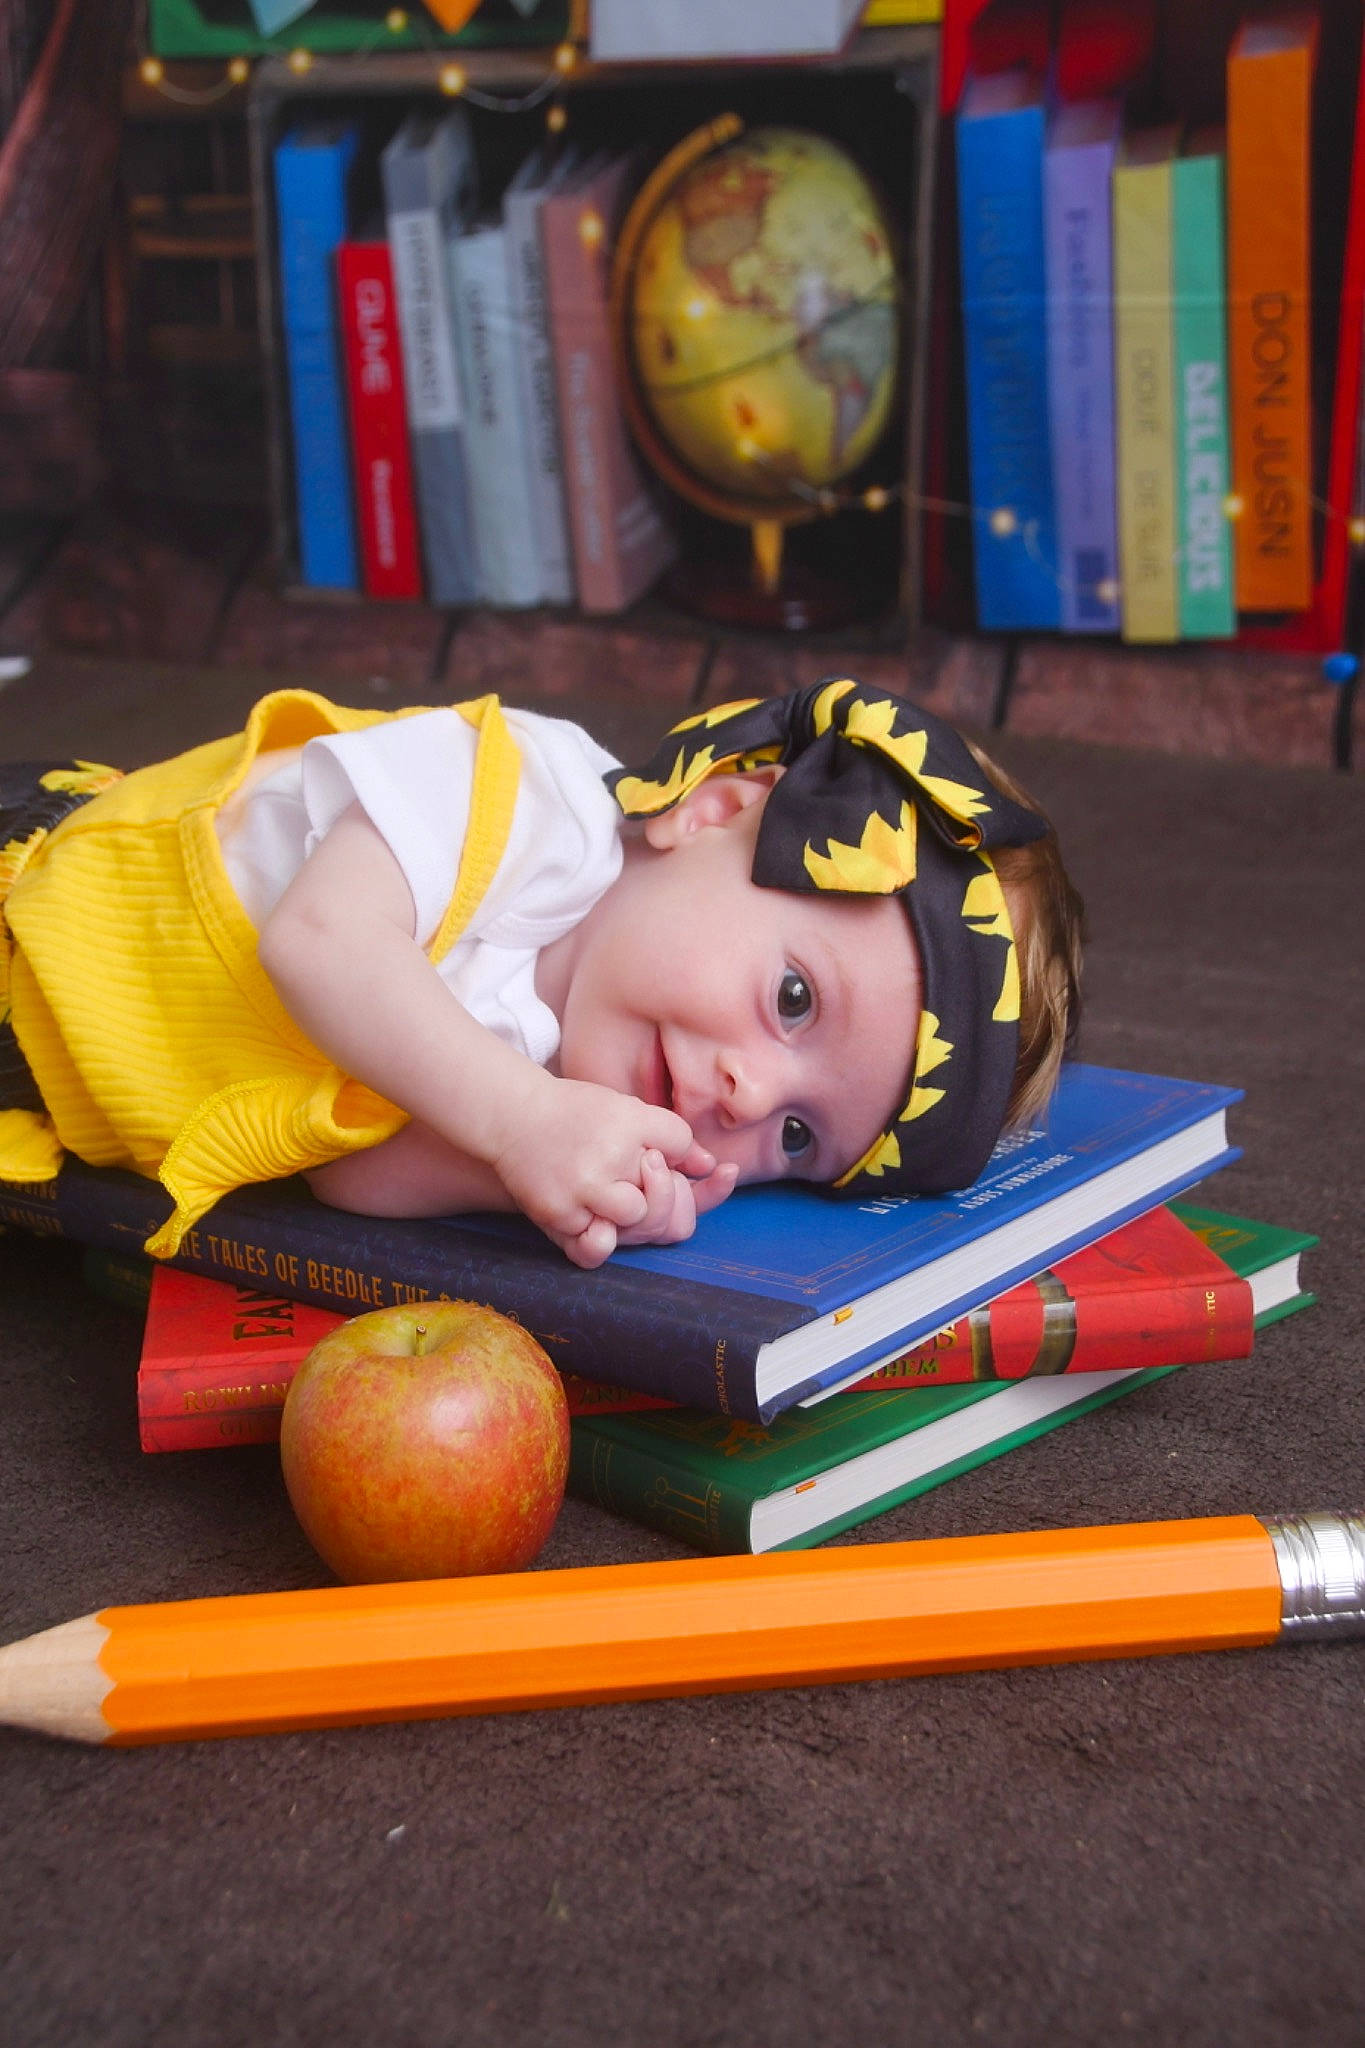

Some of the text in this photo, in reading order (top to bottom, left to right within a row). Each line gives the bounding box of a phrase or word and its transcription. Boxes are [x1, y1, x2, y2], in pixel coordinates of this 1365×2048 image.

[1252, 293, 1291, 407] DON
[208, 1235, 269, 1276] TALES
[275, 1252, 299, 1287] OF
[306, 1258, 384, 1307] BEEDLE
